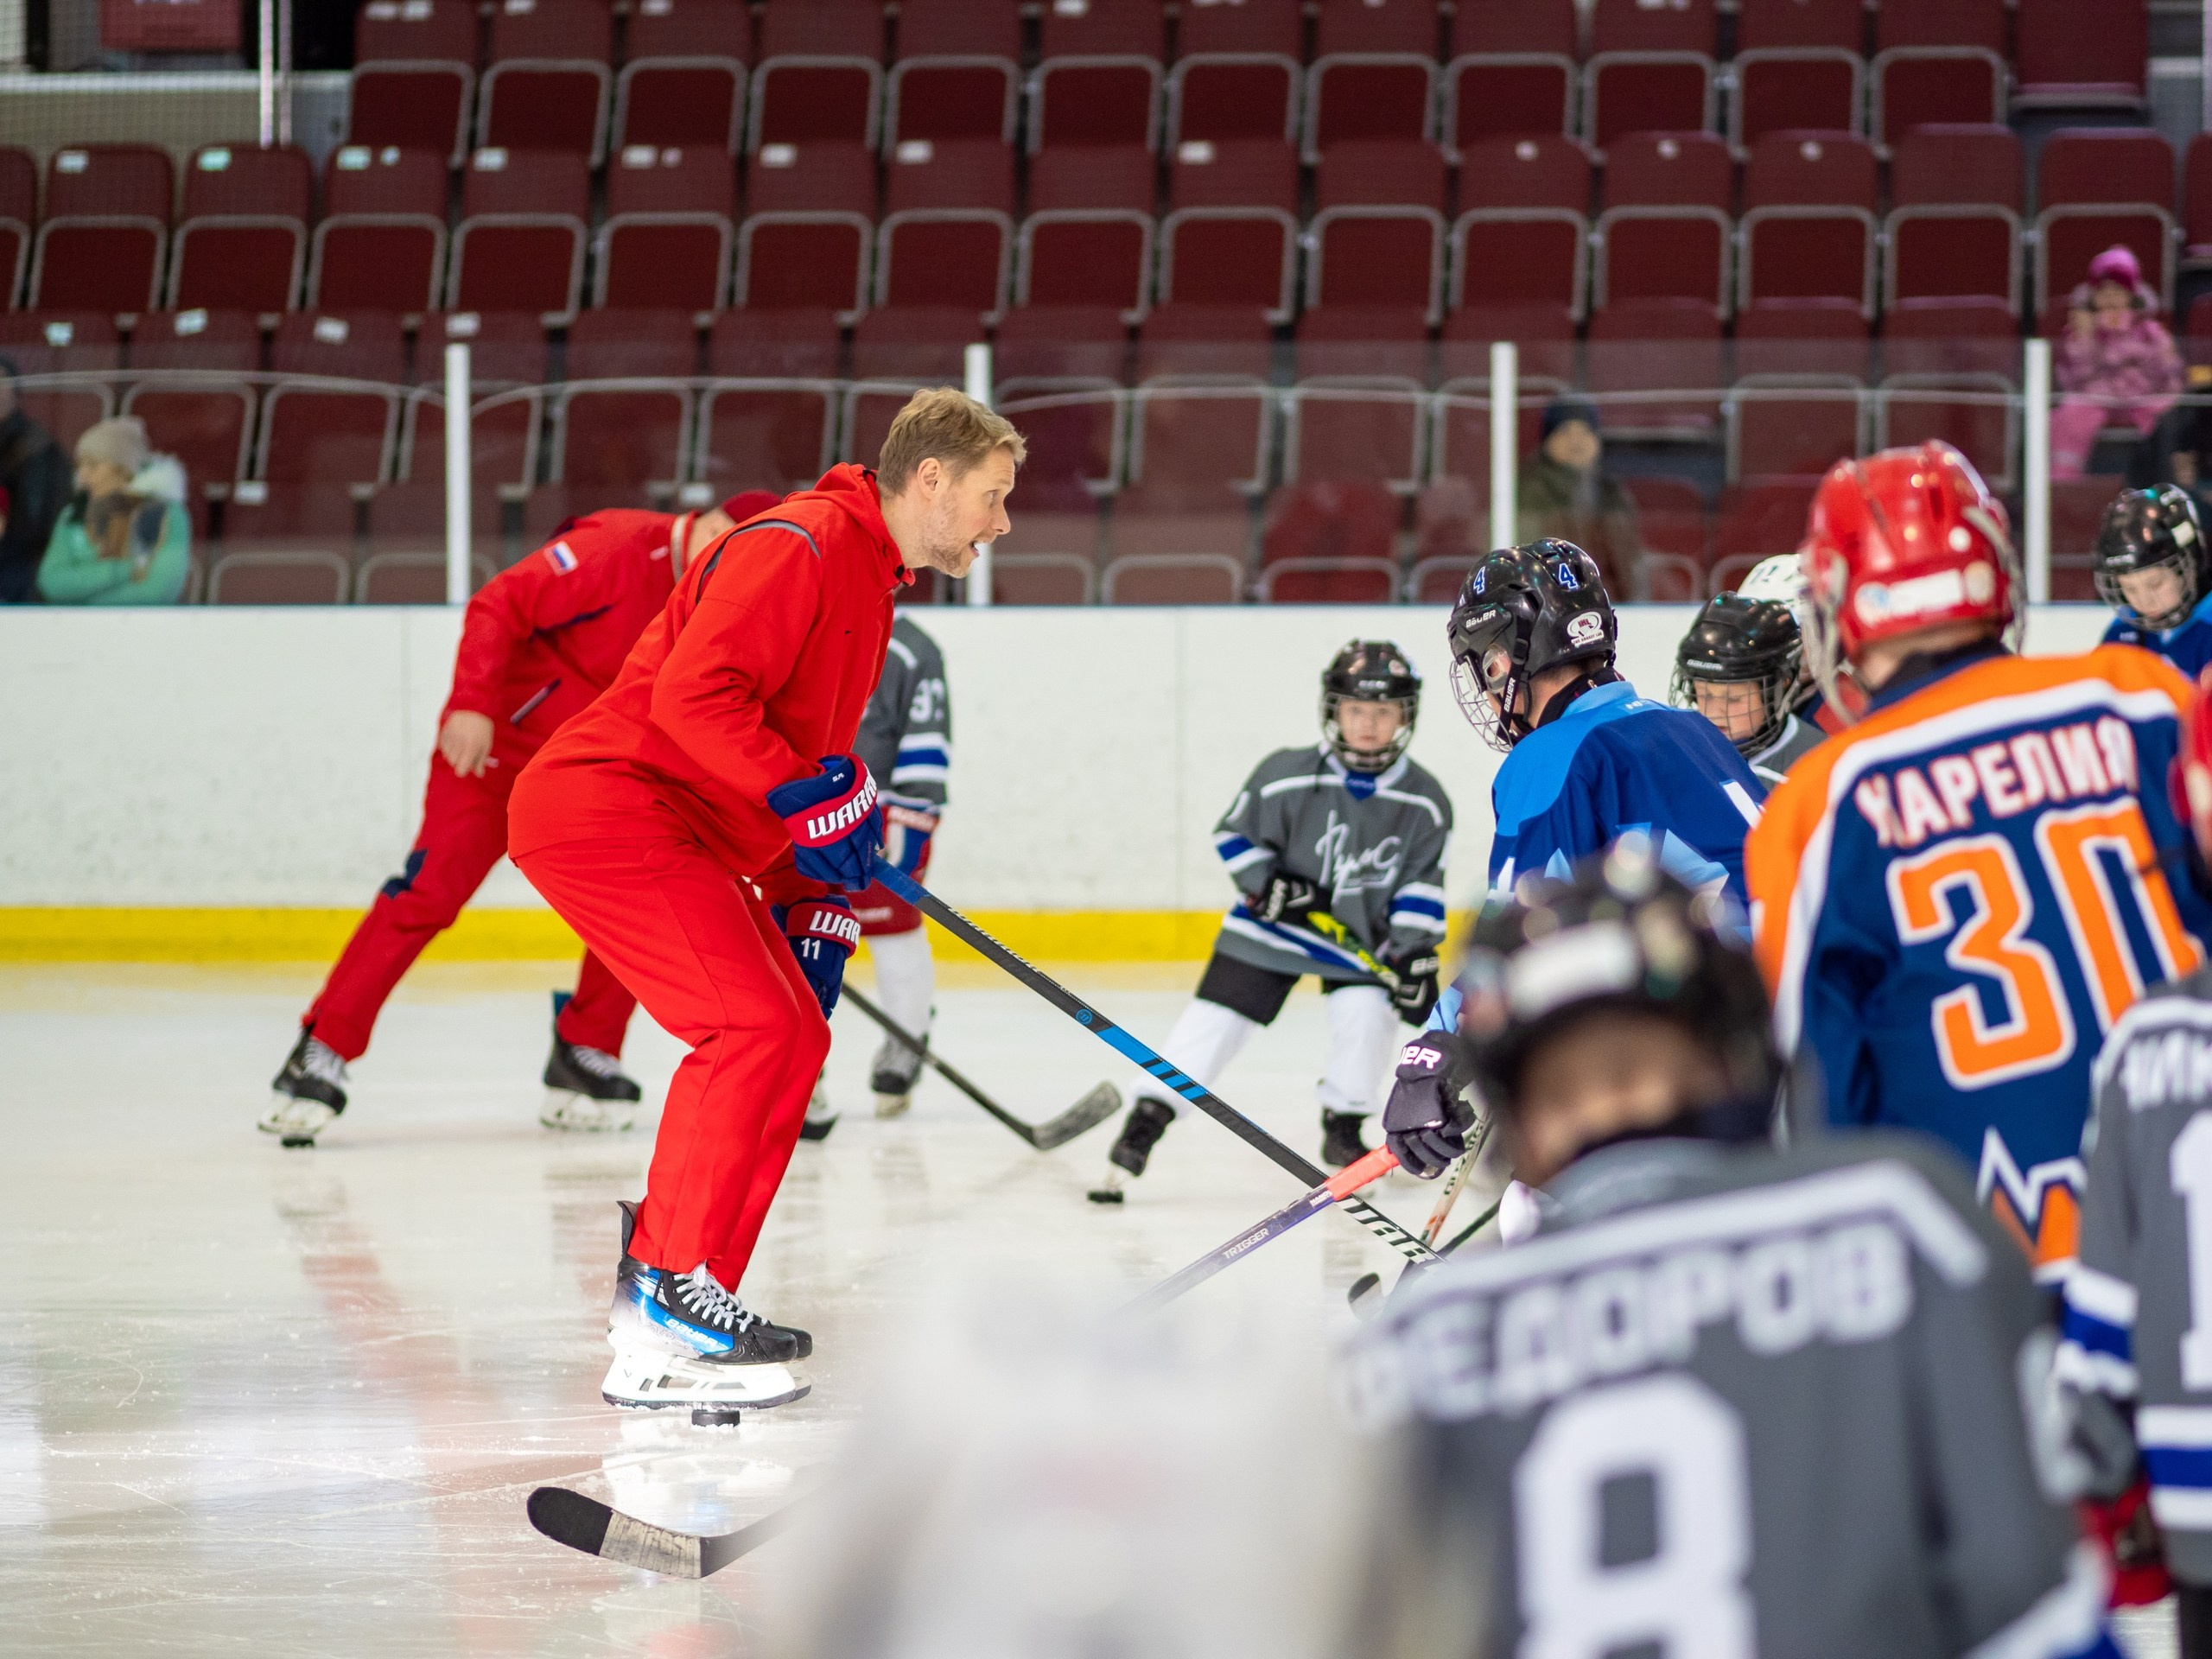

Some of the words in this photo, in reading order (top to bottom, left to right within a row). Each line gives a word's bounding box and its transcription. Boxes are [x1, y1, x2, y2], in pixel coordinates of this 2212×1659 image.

[1473, 565, 1485, 594] 4
[1559, 563, 1579, 588] 4
[1465, 609, 1496, 628] BAUER
[1504, 677, 1516, 712] BAUER
[801, 938, 820, 960] 11
[1222, 1227, 1269, 1259] TRIGGER
[665, 1318, 718, 1346] BAUER
[1514, 1372, 1758, 1659] 8
